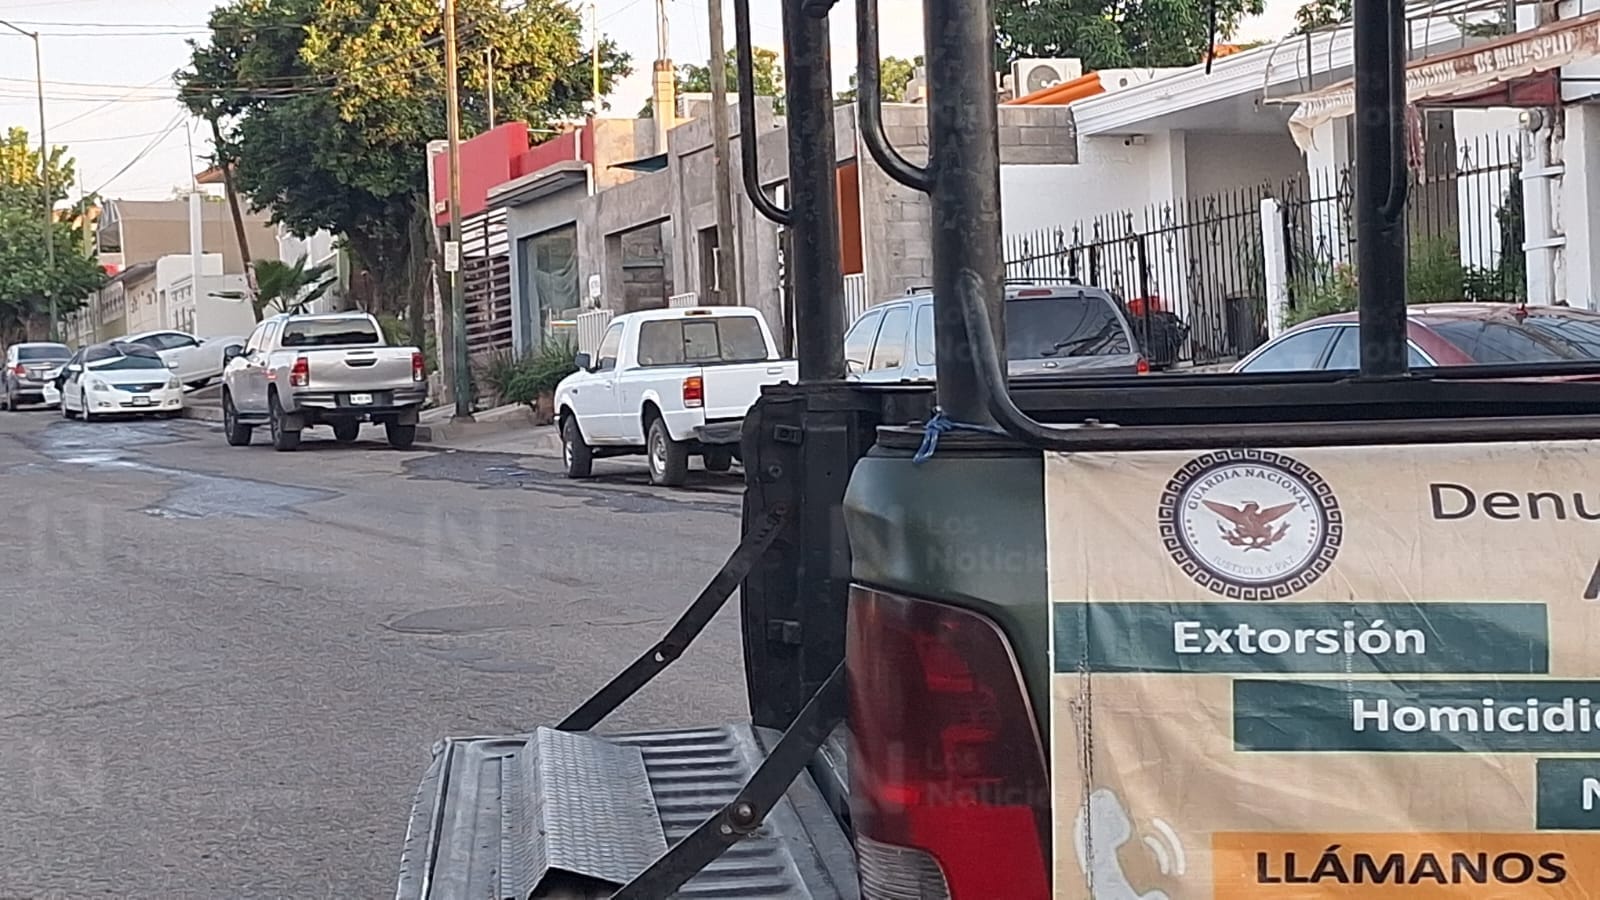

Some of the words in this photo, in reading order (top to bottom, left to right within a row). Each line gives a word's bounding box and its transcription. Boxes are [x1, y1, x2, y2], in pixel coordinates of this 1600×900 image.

[1473, 51, 1496, 75] DE
[1187, 470, 1242, 511] GUARDIA
[1244, 468, 1312, 513] NACIONAL
[1430, 483, 1600, 520] Denu
[1173, 619, 1426, 655] Extorsión
[1352, 698, 1600, 733] Homicidi
[1257, 844, 1568, 884] LLÁMANOS
